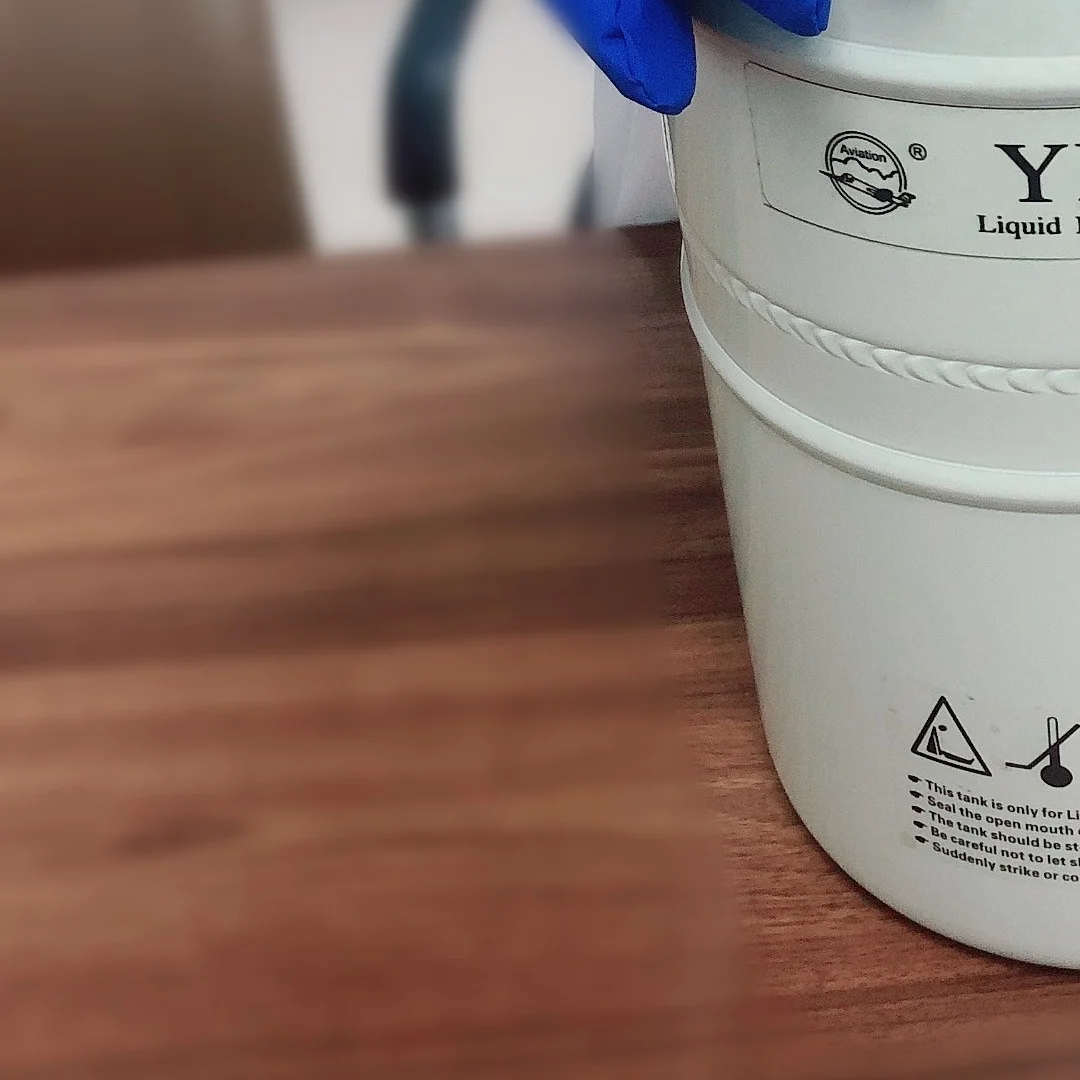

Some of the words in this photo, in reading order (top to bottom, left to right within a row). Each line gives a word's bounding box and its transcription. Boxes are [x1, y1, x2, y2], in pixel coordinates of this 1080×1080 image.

[840, 144, 887, 163] Aviation
[977, 214, 1062, 239] Liquid
[925, 779, 954, 798] This
[957, 791, 989, 808] tank
[991, 798, 1003, 810] is
[1007, 805, 1038, 818] only
[1042, 807, 1063, 819] for
[927, 796, 956, 814] Seal
[959, 806, 982, 821] the
[986, 814, 1021, 829] open
[1026, 822, 1074, 836] mouth
[929, 810, 954, 827] The
[957, 821, 987, 838] tank
[991, 831, 1040, 848] should
[1044, 839, 1061, 850] be
[931, 826, 948, 841] Be
[950, 834, 998, 855] careful
[1001, 848, 1025, 861] not
[1029, 852, 1044, 863] to
[1047, 855, 1066, 866] let
[932, 842, 996, 871] Suddenly
[999, 863, 1040, 878] strike
[1044, 871, 1059, 880] or
